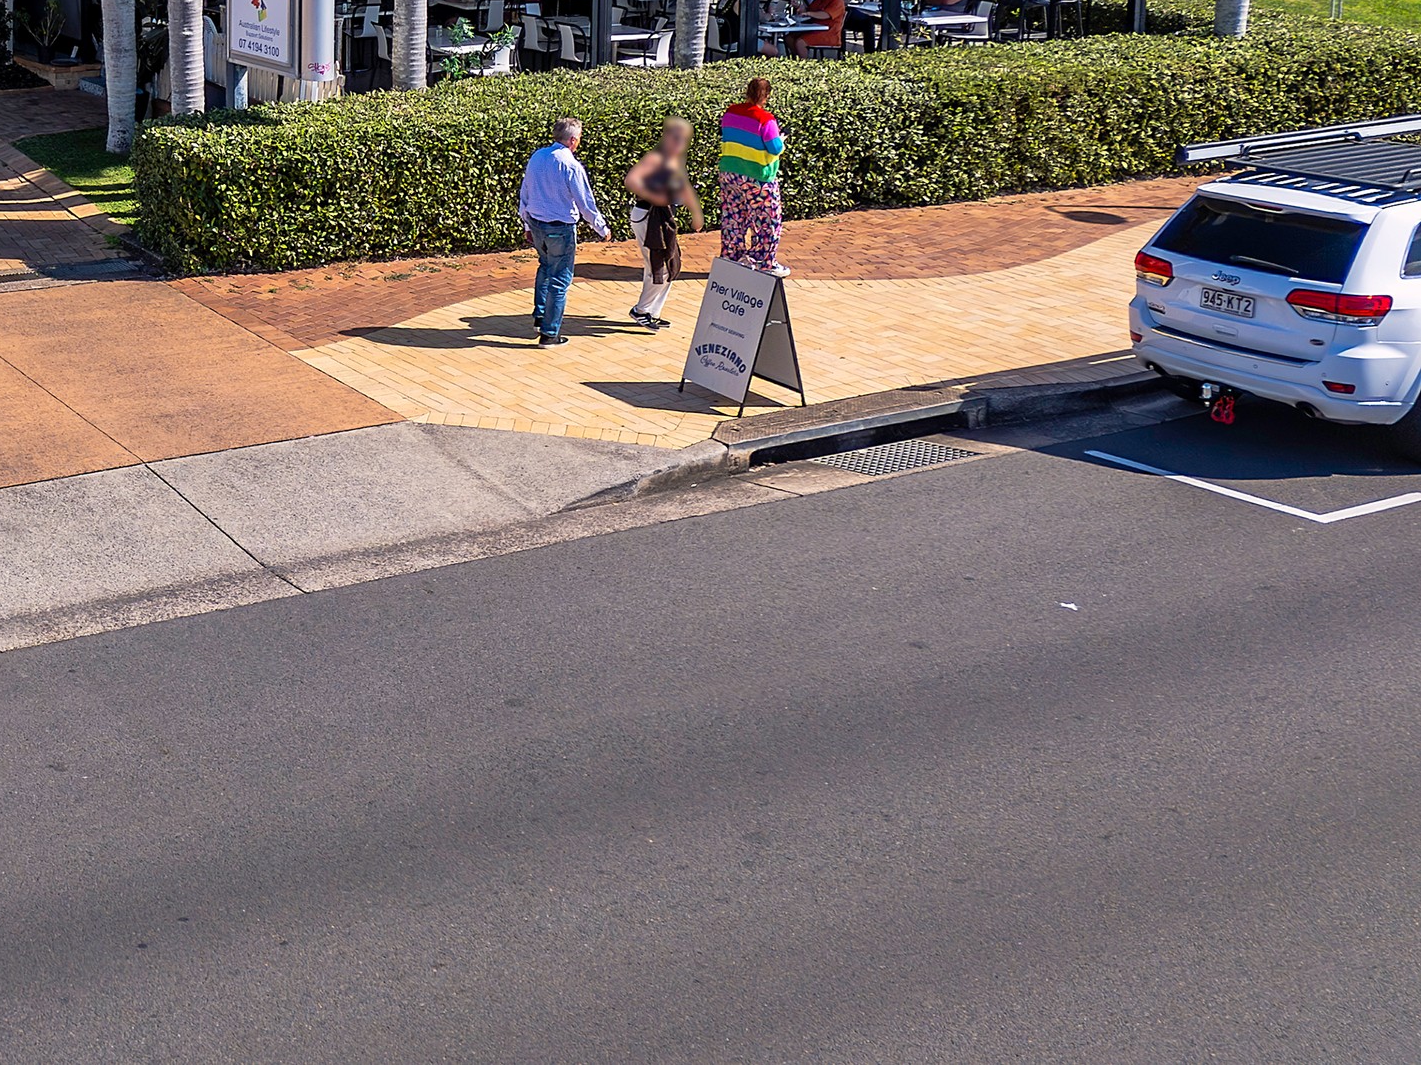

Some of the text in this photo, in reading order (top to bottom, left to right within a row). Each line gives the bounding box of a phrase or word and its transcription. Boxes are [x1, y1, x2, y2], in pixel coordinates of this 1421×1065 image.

[238, 38, 280, 57] 07 4194 3100
[1211, 270, 1241, 286] Jeep
[710, 281, 764, 309] Pier Village
[722, 300, 745, 316] Cafe
[695, 343, 747, 374] VENEZIANO
